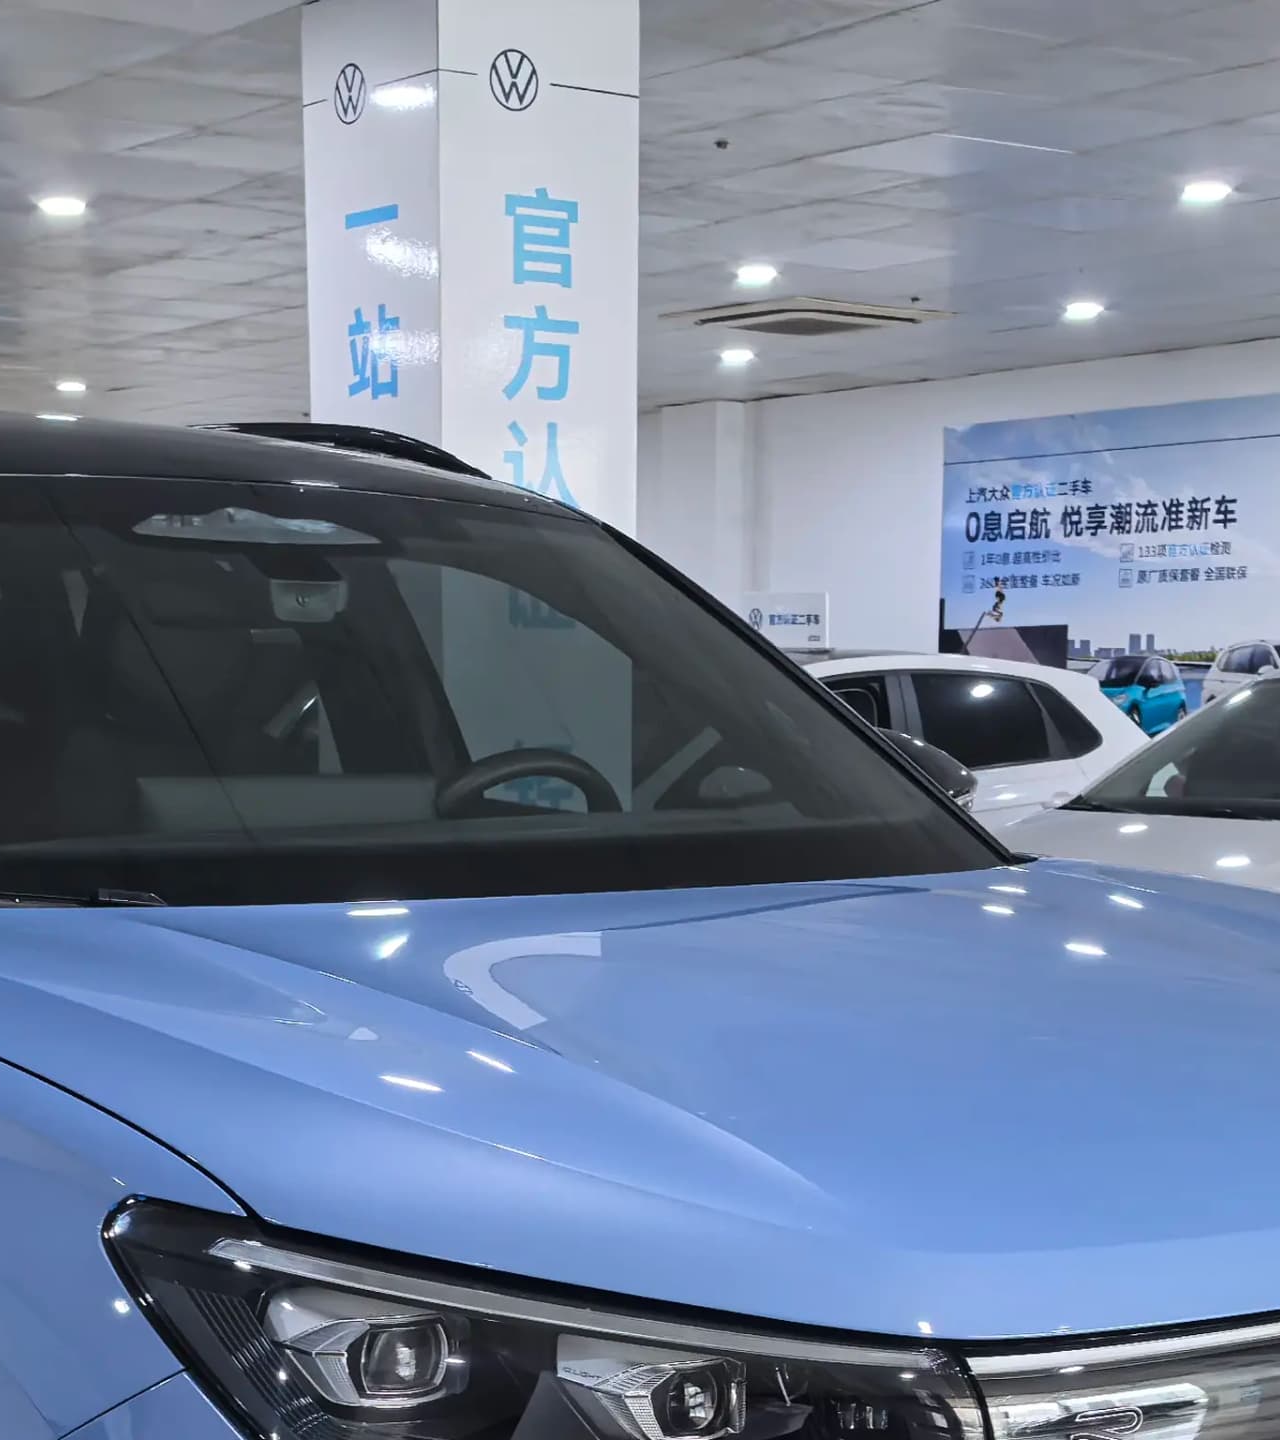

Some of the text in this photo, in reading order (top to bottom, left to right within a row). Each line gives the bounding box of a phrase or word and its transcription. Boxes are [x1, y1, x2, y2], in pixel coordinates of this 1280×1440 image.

[966, 479, 1092, 503] 上汽大众官方认证二手车
[966, 494, 1238, 542] 0息启航 悦享潮流准新车
